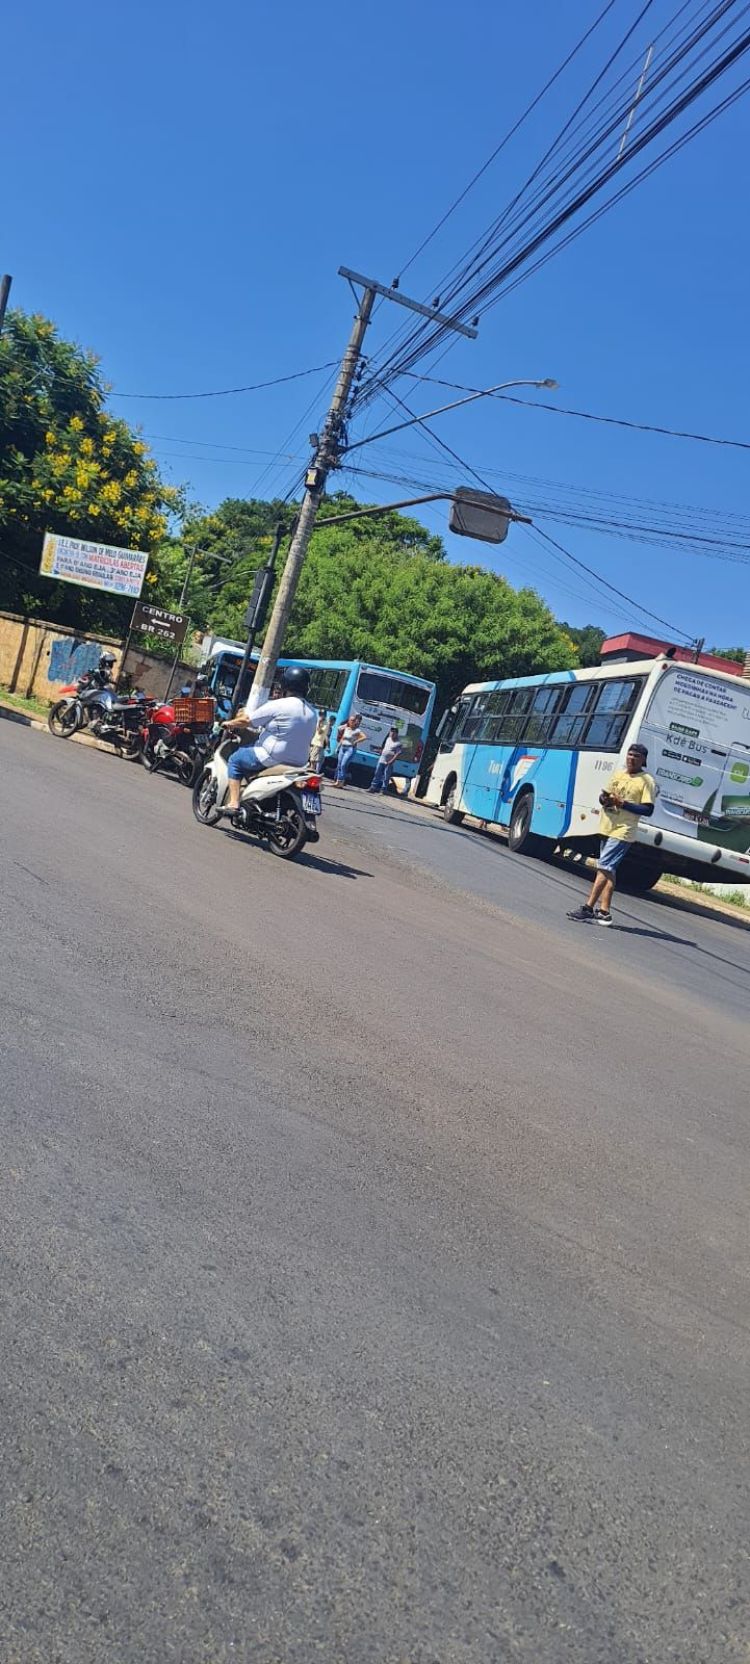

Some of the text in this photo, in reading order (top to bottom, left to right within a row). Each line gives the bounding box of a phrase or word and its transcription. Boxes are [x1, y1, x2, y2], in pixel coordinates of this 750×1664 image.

[57, 556, 72, 565] PARA
[80, 561, 93, 569] ANO
[142, 606, 183, 623] CENTRO
[141, 624, 156, 633] BR
[157, 628, 176, 640] 262
[676, 674, 696, 684] CHEGA
[704, 682, 726, 693] CONTAR
[718, 693, 734, 702] HORA
[666, 733, 709, 754] Kdê Bus
[594, 760, 614, 772] 1196
